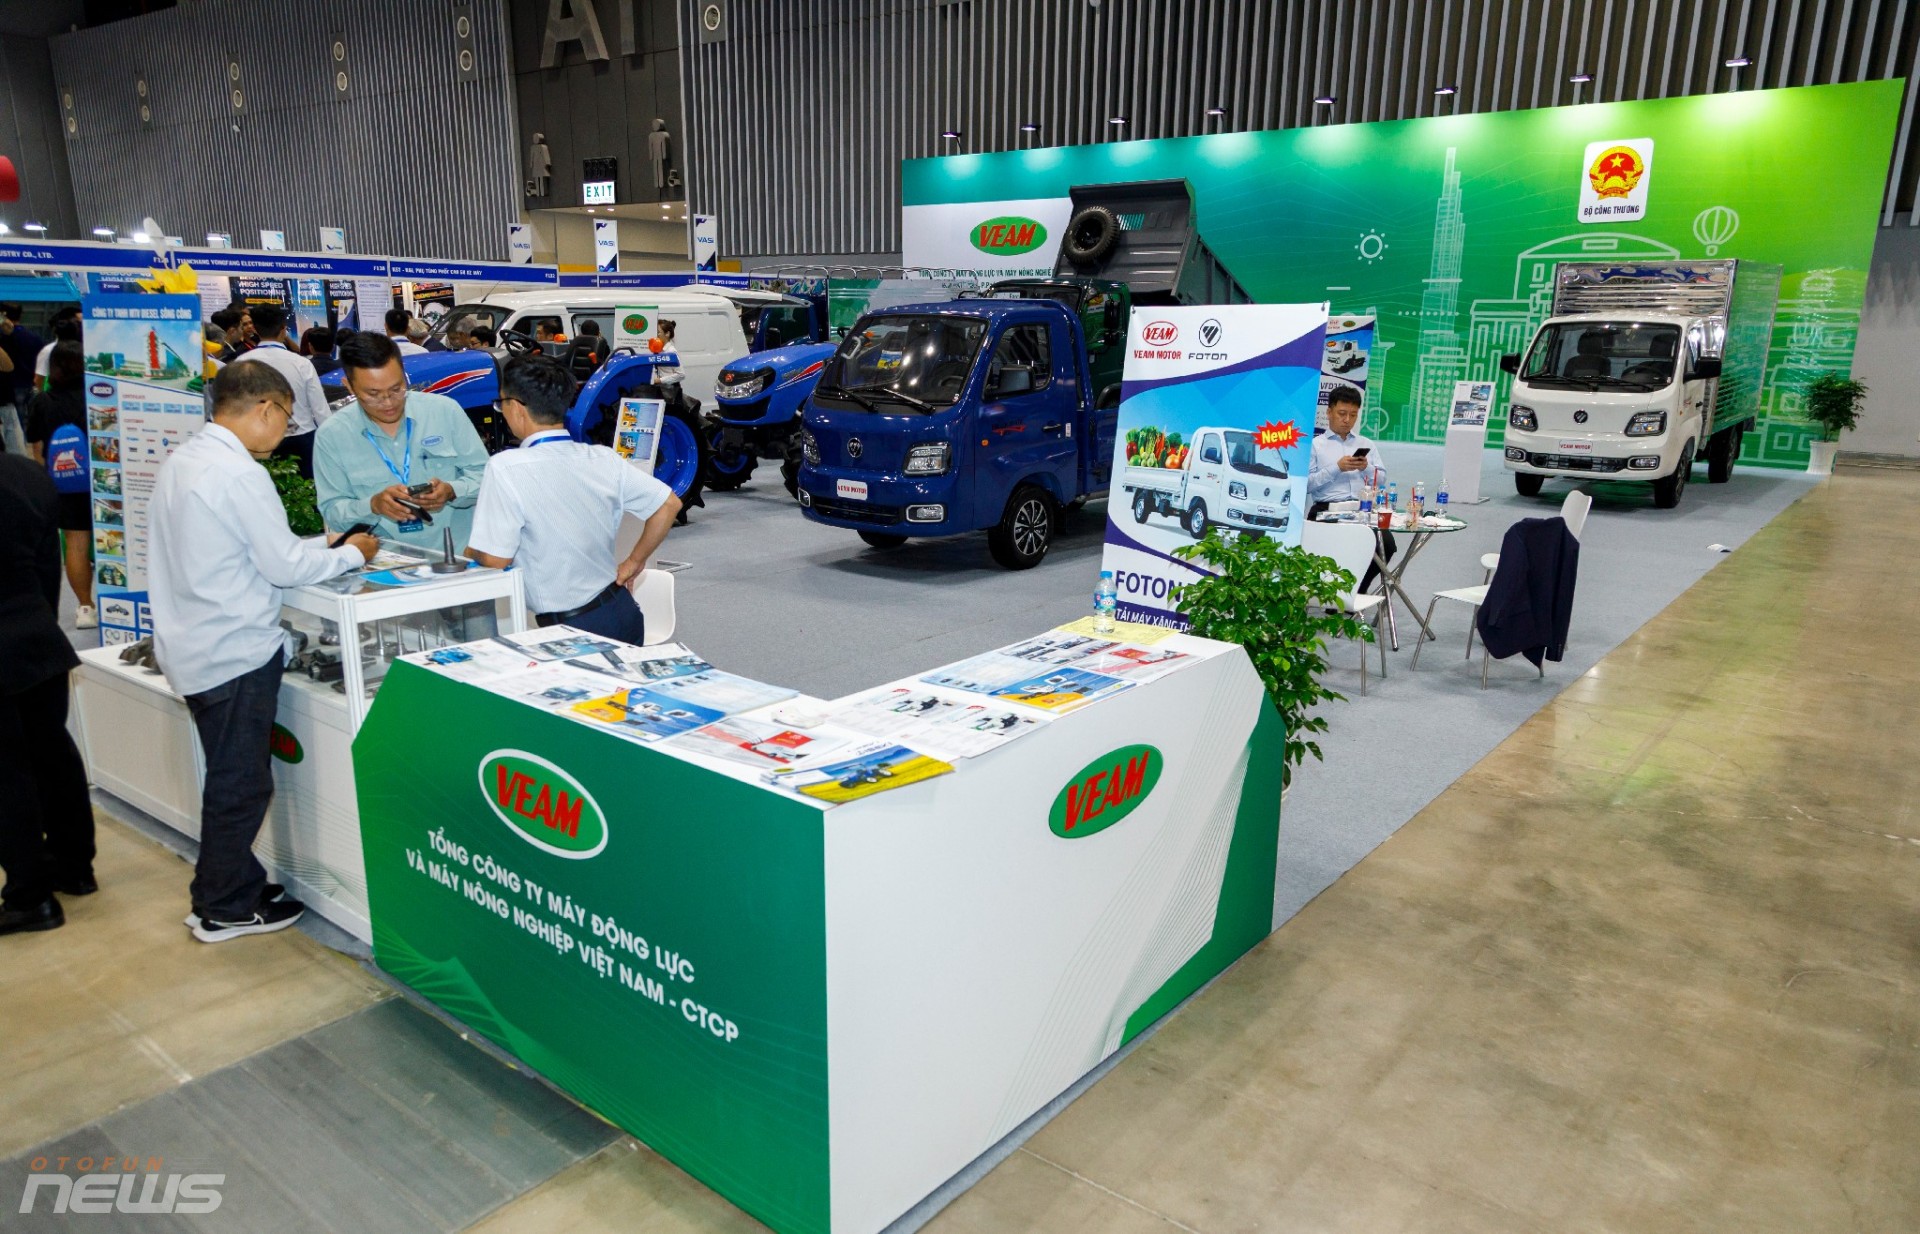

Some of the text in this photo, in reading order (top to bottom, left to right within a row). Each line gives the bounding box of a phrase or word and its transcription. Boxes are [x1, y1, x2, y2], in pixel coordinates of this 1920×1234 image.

[586, 184, 612, 198] EXIT
[1584, 204, 1640, 217] BỘ CÔNG THƯƠNG
[980, 223, 1037, 248] VEAM
[1004, 268, 1016, 276] MÁY
[1018, 267, 1034, 276] NÔNG
[1145, 326, 1173, 340] VEAM
[1134, 350, 1181, 360] VEAM MOTOR
[1262, 424, 1292, 444] New!
[1116, 570, 1182, 602] FOTON
[1116, 606, 1129, 620] TẢI
[1132, 611, 1151, 624] MÁY
[1152, 614, 1178, 630] XĂNG
[496, 763, 584, 840] VEAM
[1064, 750, 1150, 832] VEAM
[427, 826, 695, 983] TỔNG CÔNG TY MÁY ĐỘNG LỰC
[406, 848, 427, 874] VÀ
[428, 860, 459, 892] MÁY
[463, 879, 510, 919] NÔNG
[513, 906, 574, 955] NGHIỆP
[578, 940, 614, 978] VIỆT
[619, 963, 664, 1005] NAM
[681, 998, 739, 1043] CTCP
